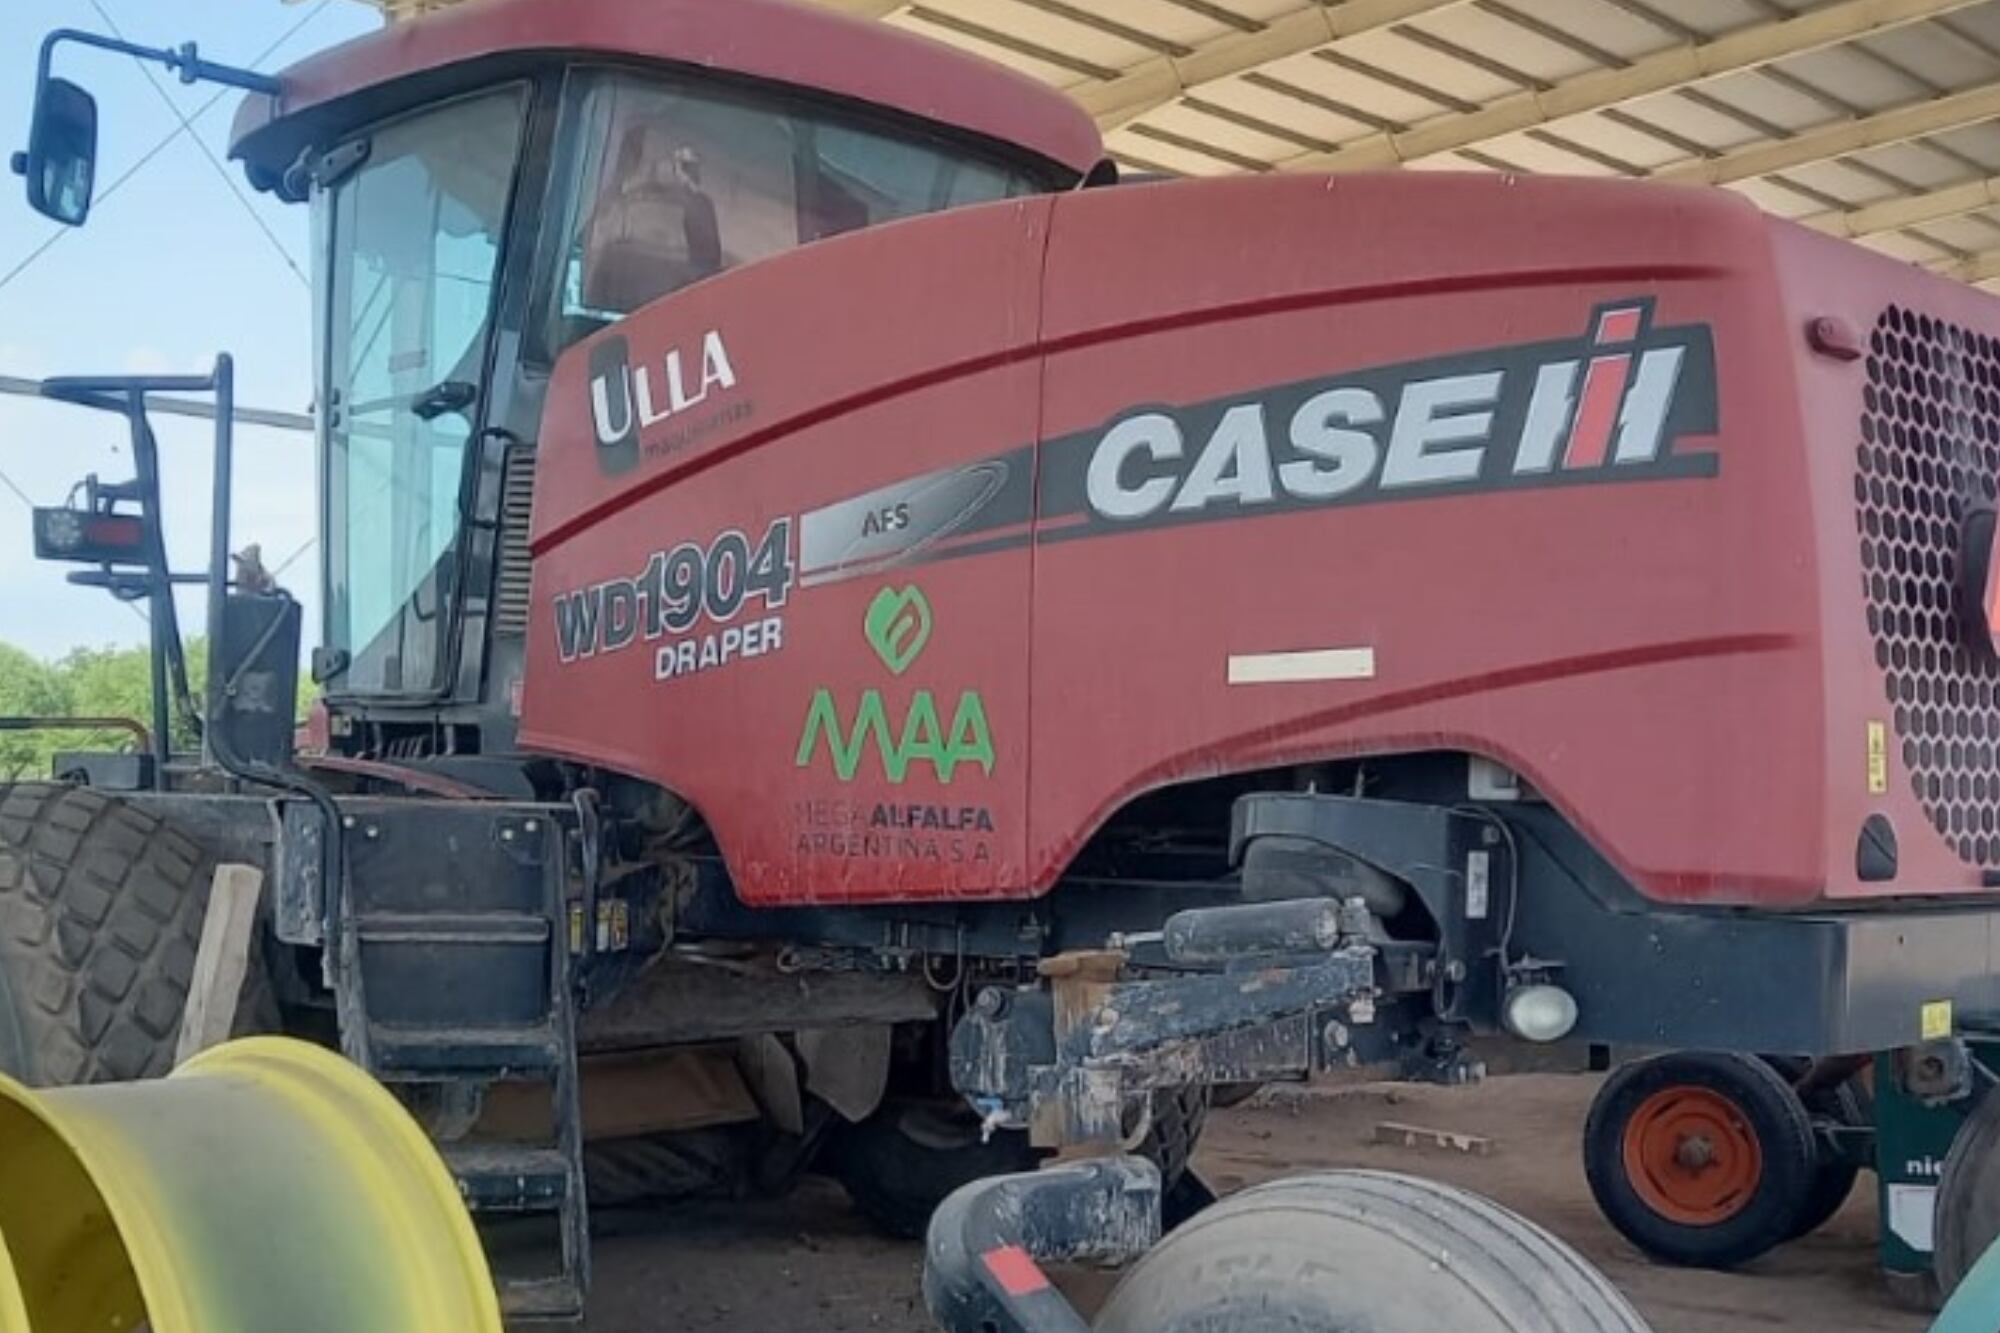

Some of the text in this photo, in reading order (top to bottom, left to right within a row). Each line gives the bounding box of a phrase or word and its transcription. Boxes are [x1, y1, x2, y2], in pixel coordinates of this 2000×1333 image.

[591, 330, 736, 445] ULLA
[1086, 306, 1687, 519] CASE IH
[645, 402, 753, 458] maquiarias
[861, 503, 910, 538] AFS
[554, 516, 794, 663] WD1904
[655, 616, 782, 681] DRAPER
[796, 688, 996, 785] MAA
[796, 832, 942, 862] ARGENTINA
[870, 803, 995, 832] ALFALFA
